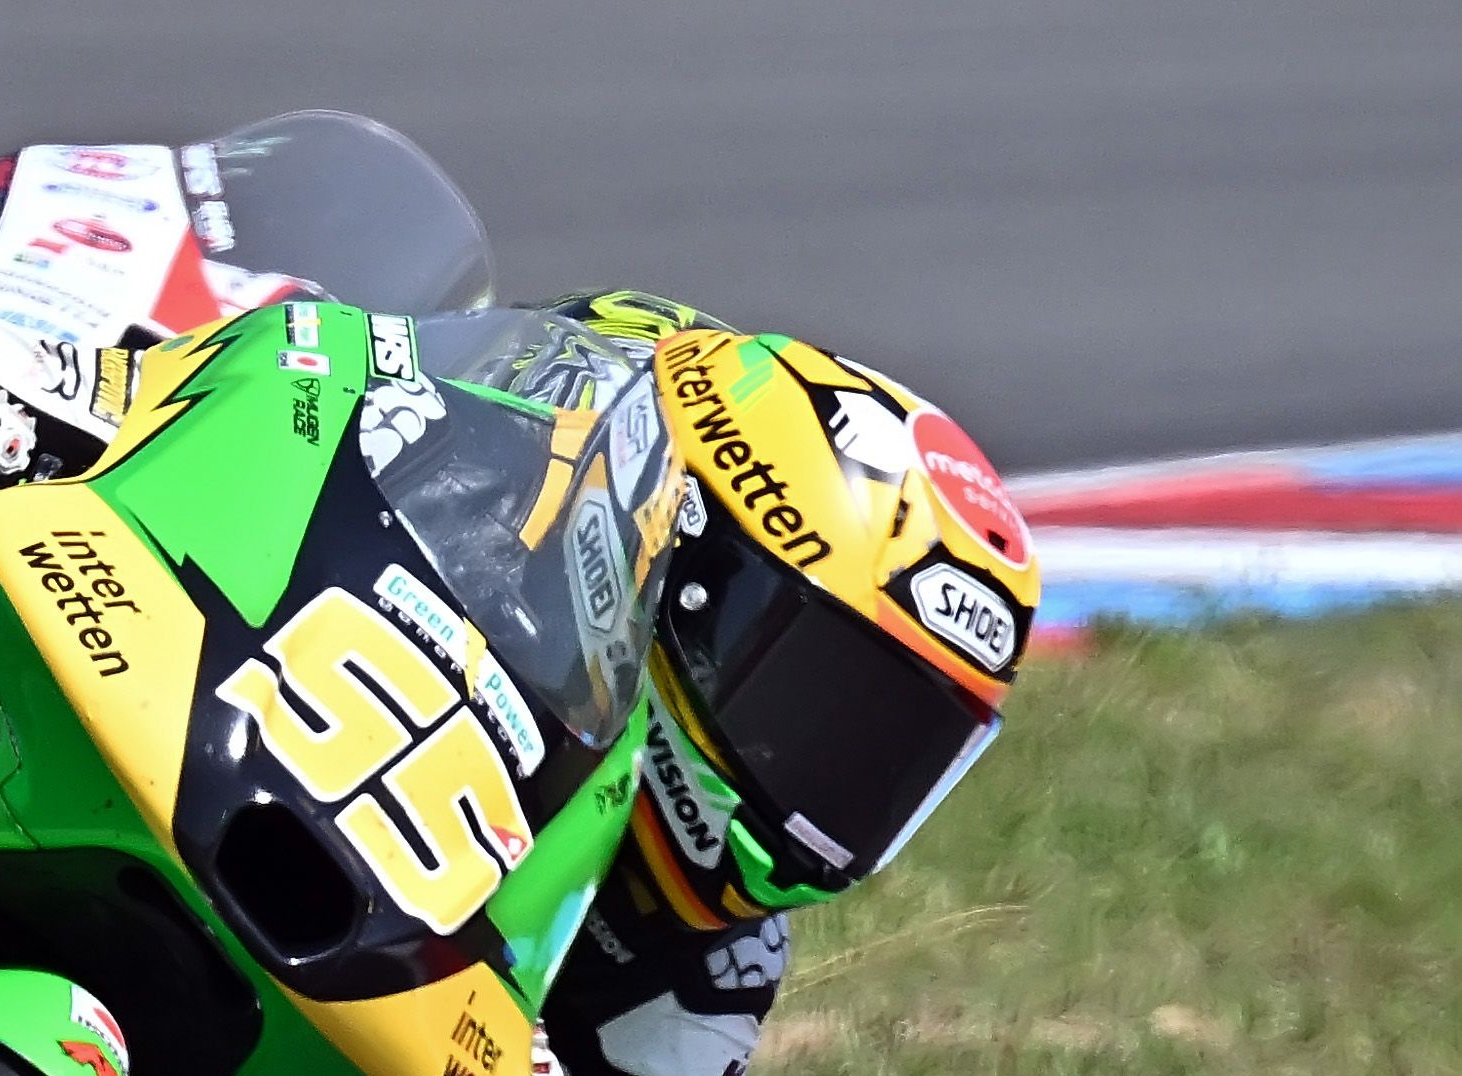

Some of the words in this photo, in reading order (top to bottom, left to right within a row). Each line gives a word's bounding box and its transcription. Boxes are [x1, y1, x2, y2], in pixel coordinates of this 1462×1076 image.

[18, 541, 130, 678] wetten
[50, 531, 142, 614] inter
[387, 576, 455, 642] Green
[485, 673, 534, 753] Power
[214, 585, 535, 937] 55
[648, 721, 720, 852] VISION
